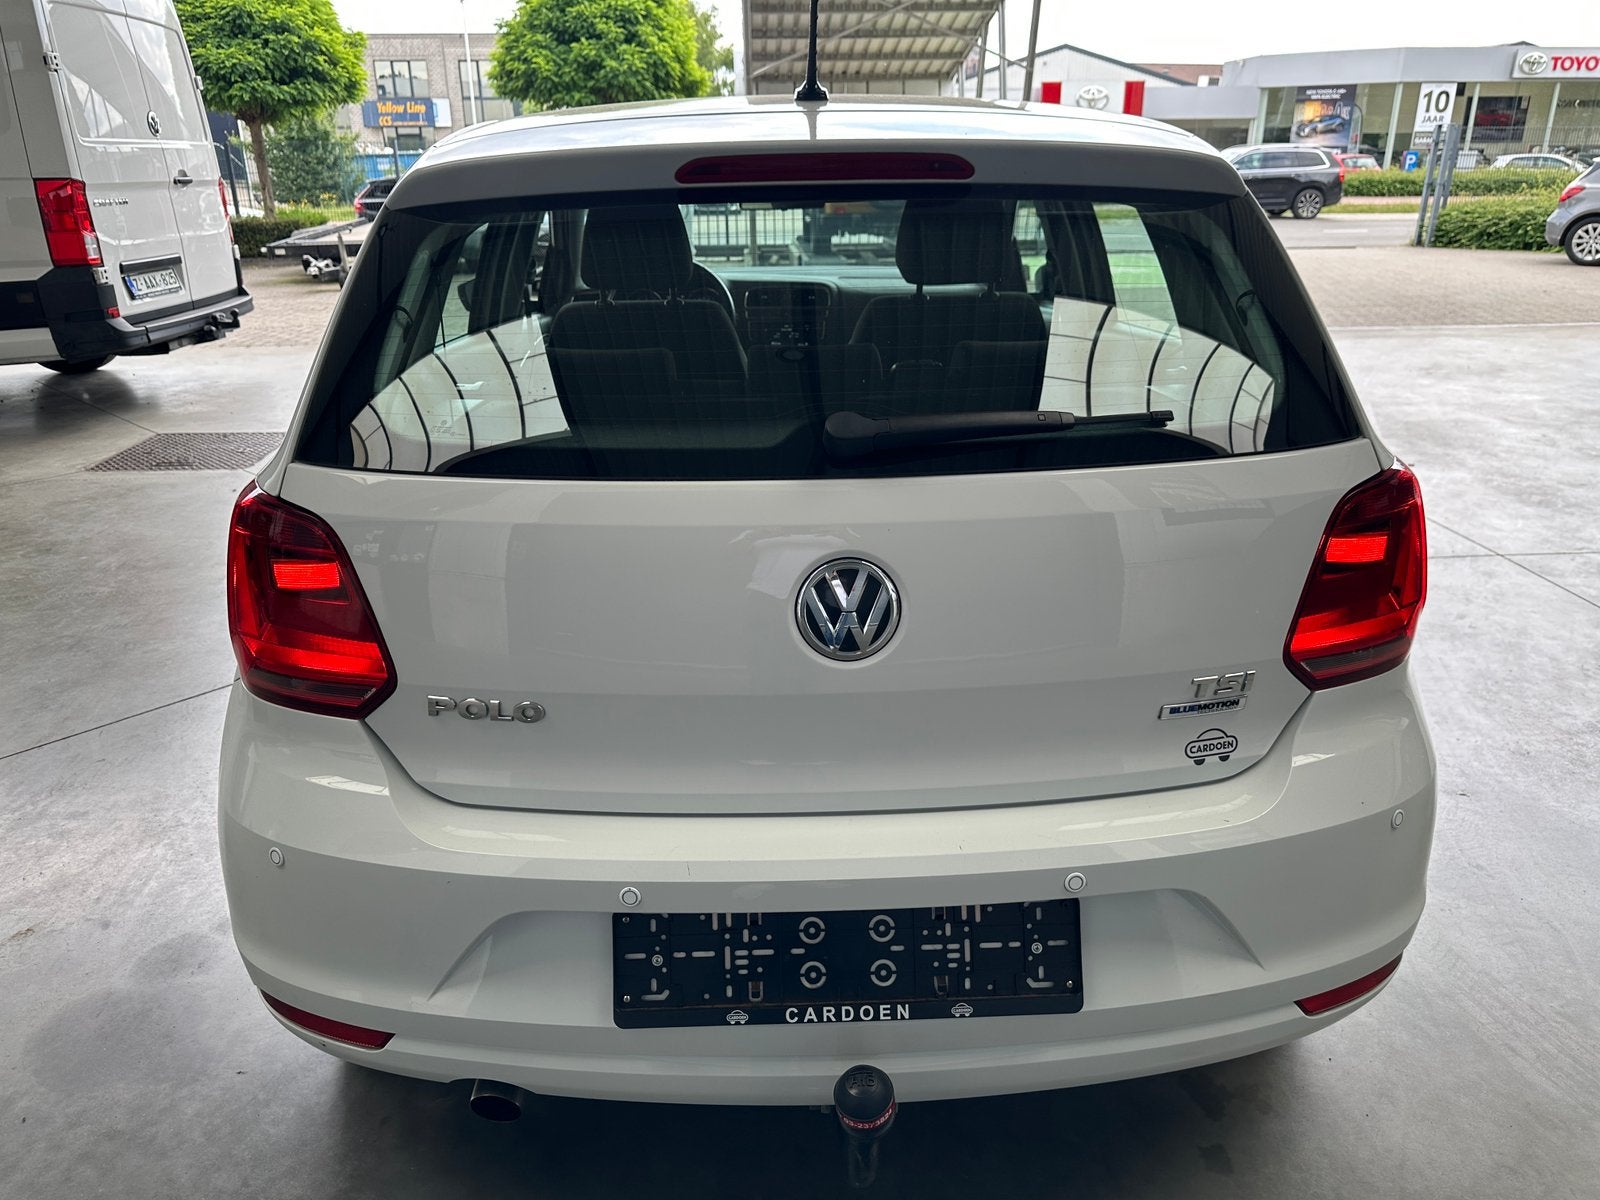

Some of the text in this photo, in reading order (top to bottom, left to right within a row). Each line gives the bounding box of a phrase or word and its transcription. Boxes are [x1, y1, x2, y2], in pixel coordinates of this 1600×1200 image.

[1551, 56, 1600, 71] TOYO
[376, 101, 426, 114] Yellow Line
[1423, 90, 1450, 113] 10
[1421, 115, 1445, 123] JAAR
[1405, 154, 1416, 171] P
[1191, 670, 1256, 698] TSI
[427, 695, 546, 723] POLO
[1169, 699, 1240, 715] BLUEMOTION
[1189, 740, 1234, 754] CARDOEN
[784, 1003, 910, 1023] CARDOEN
